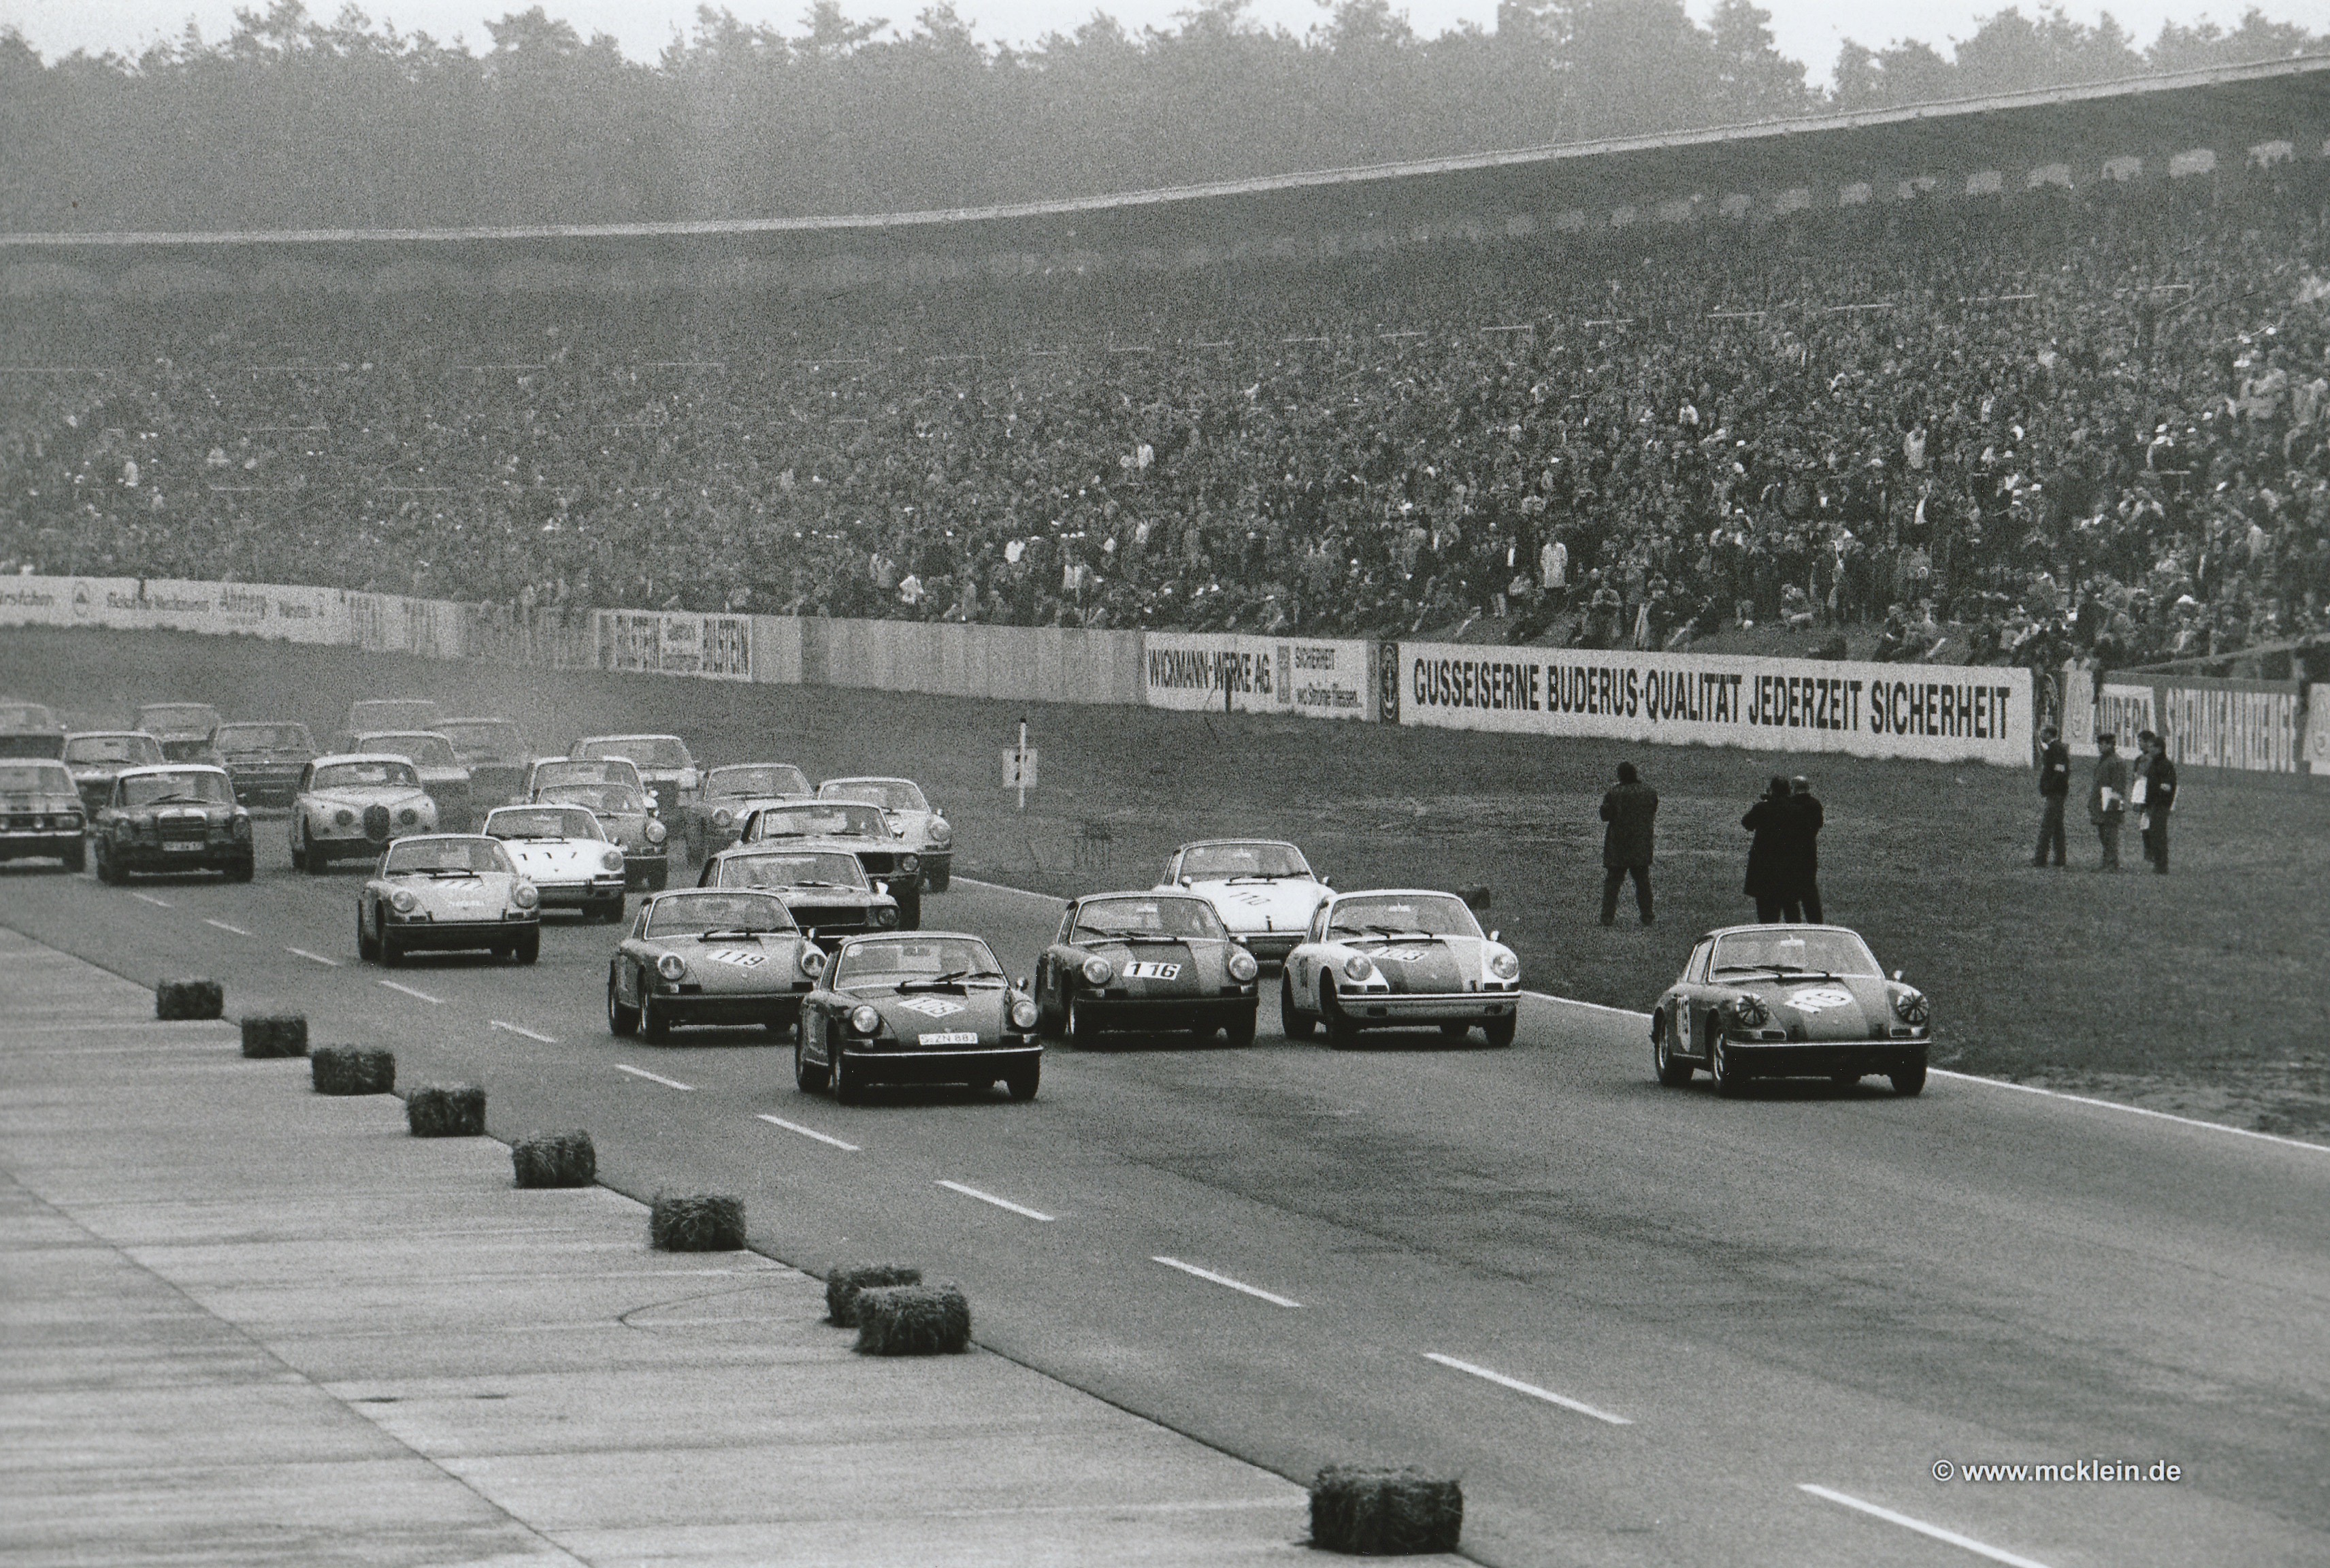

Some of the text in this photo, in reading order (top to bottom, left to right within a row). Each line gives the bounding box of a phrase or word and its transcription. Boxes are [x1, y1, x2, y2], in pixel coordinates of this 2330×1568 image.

[1254, 653, 1272, 694] AG
[1296, 647, 1335, 670] SICHERHEIT
[1414, 658, 1539, 710] GUSSEISERNE
[1548, 665, 1742, 723] BUDERUS-QUALITÄT
[1750, 675, 1862, 730] JEDERZEIT
[1871, 680, 2010, 739] SICHERHEIT
[719, 951, 766, 966] 119
